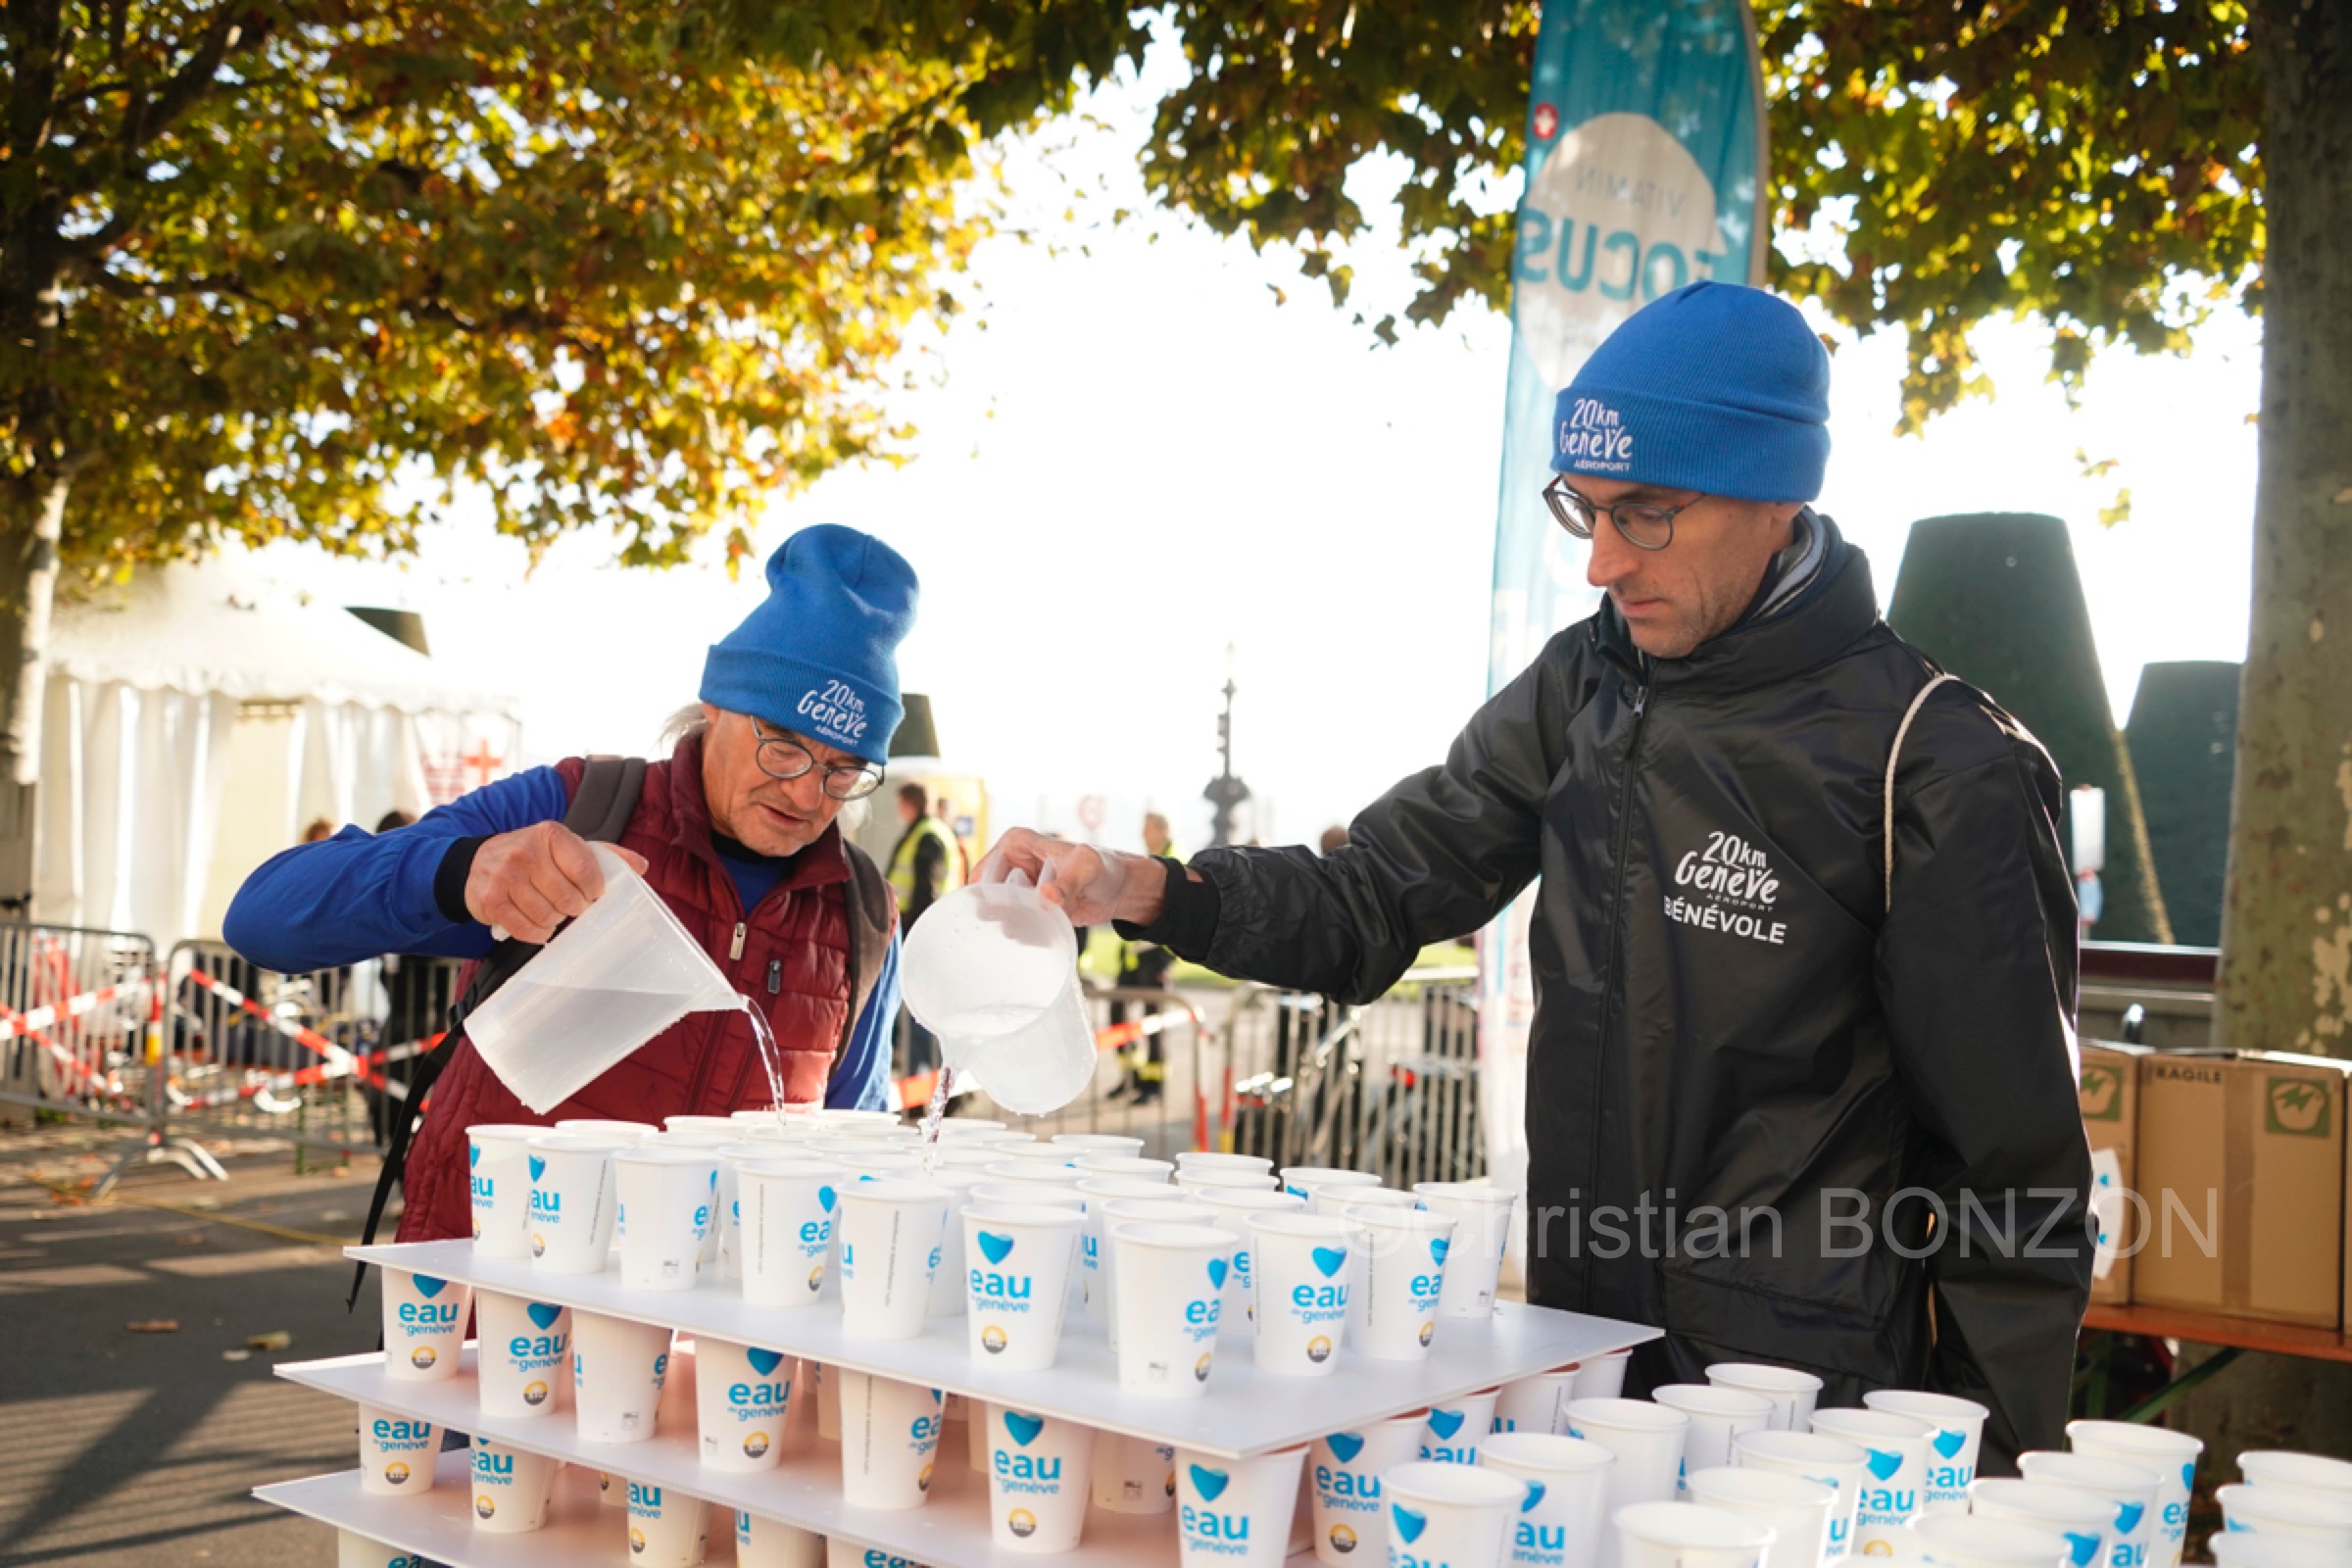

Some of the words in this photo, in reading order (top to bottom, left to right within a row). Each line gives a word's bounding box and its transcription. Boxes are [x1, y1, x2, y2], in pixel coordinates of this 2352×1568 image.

[1570, 398, 1619, 429] 20km
[1702, 831, 1767, 868] 20km
[1674, 851, 1780, 904] Genève
[1664, 896, 1788, 945] BÉNÉVOLE
[470, 1175, 493, 1197] au
[531, 1189, 561, 1211] au
[799, 1220, 830, 1243] ea
[970, 1268, 1032, 1298] eau
[1293, 1283, 1349, 1308] eau
[1409, 1274, 1443, 1297] ea
[398, 1302, 459, 1324] eau
[1185, 1298, 1221, 1324] ea
[509, 1332, 567, 1357] eau
[728, 1379, 790, 1405] eau
[372, 1419, 431, 1440] eau
[995, 1449, 1061, 1481] eau
[628, 1482, 662, 1506] au
[1317, 1465, 1381, 1498] eau
[1181, 1504, 1250, 1541] eau
[1515, 1521, 1565, 1549] au
